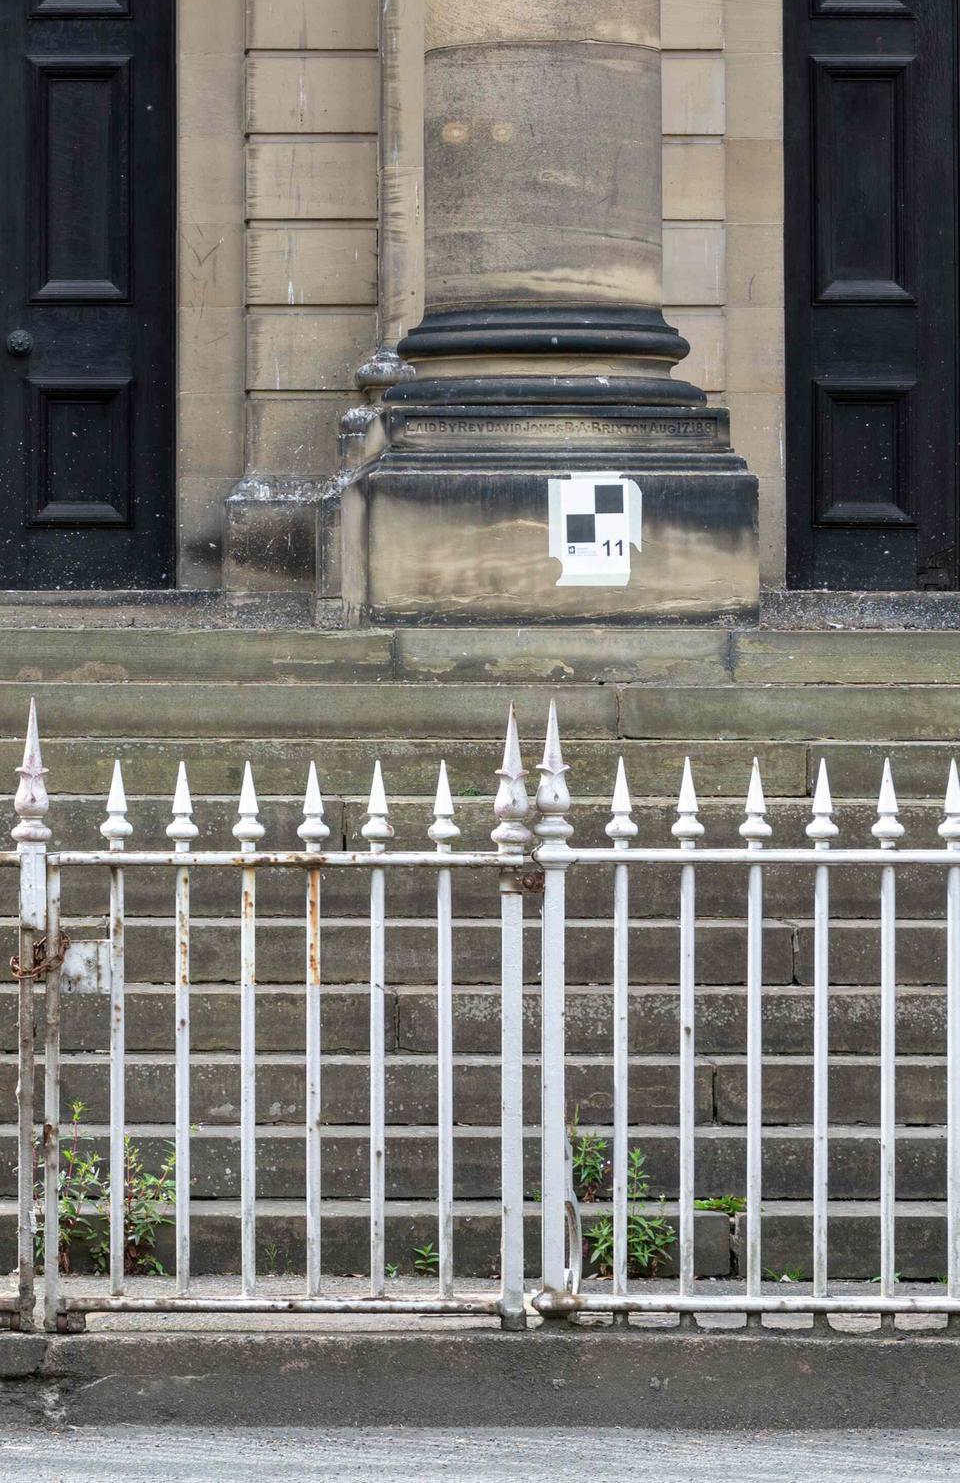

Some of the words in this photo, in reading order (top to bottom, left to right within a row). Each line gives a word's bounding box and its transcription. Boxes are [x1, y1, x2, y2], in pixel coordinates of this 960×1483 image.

[406, 421, 437, 433] LAID
[439, 421, 457, 433] BY
[486, 421, 522, 433] DAVID
[592, 421, 647, 434] BRIXTON
[649, 421, 676, 434] AUG
[602, 539, 624, 557] 11
